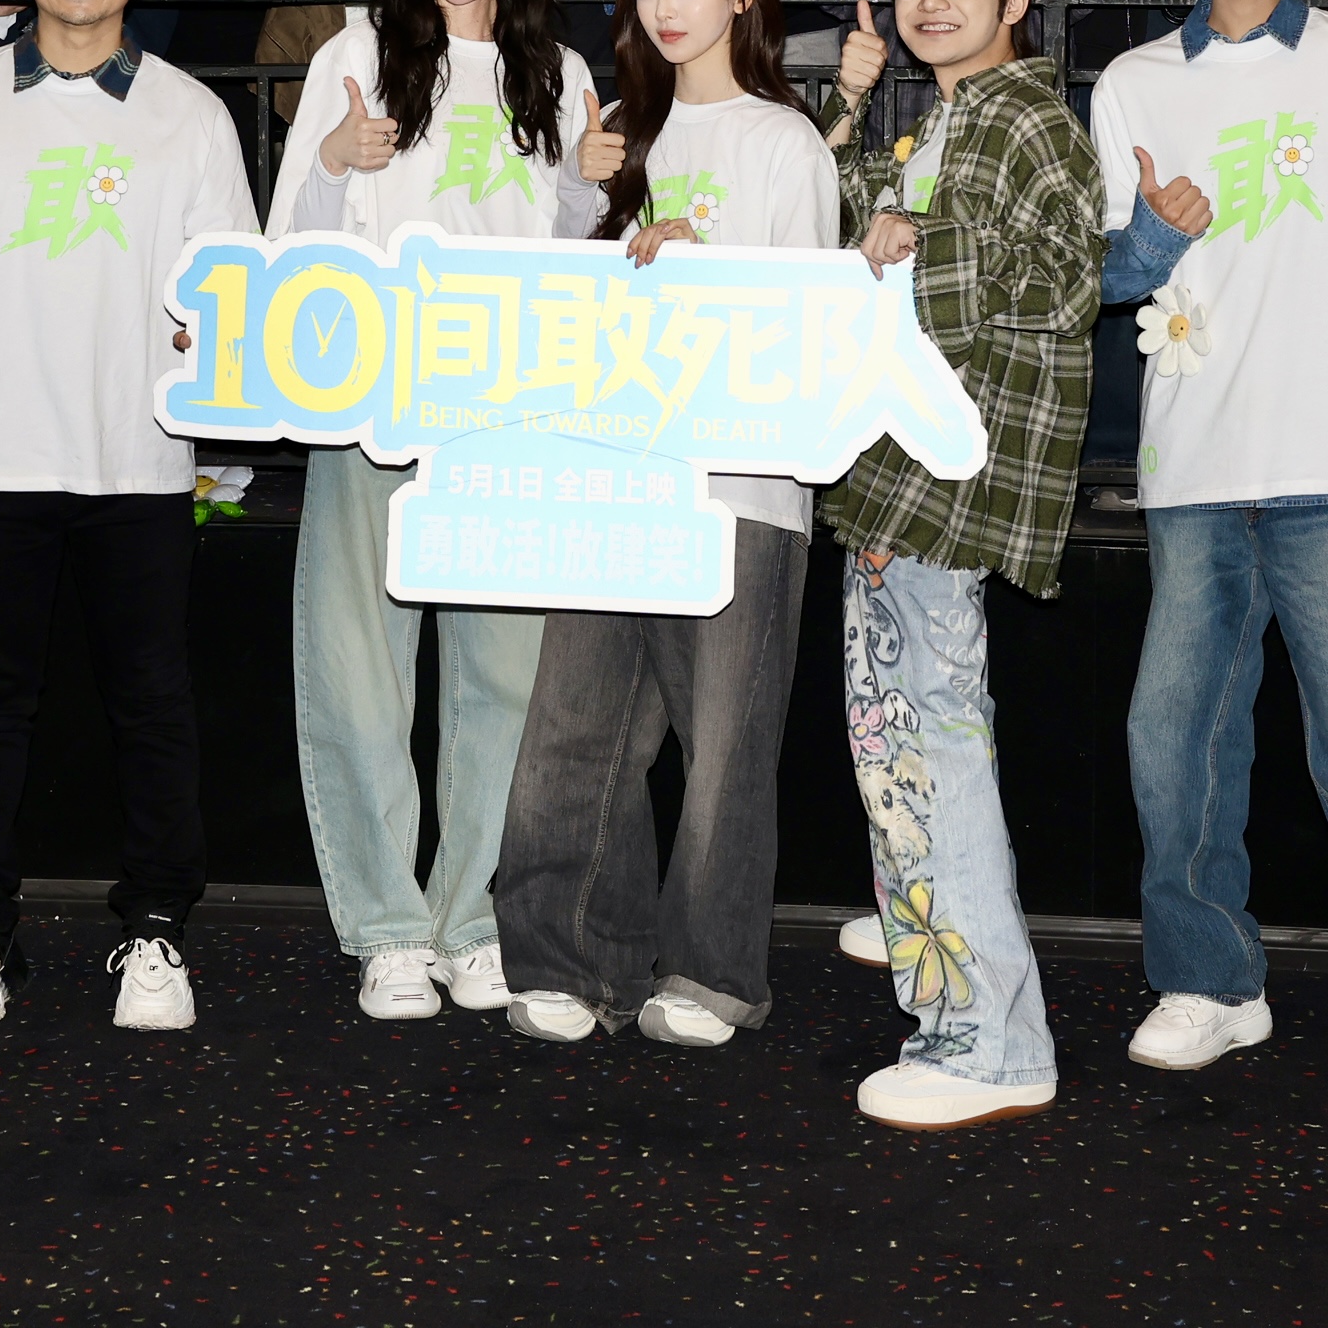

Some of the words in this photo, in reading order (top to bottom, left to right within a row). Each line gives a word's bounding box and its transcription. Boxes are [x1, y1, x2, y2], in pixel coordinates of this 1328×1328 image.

[0, 142, 136, 260] 敢
[430, 104, 535, 206] 敢
[1201, 111, 1325, 249] 敢
[183, 255, 949, 460] 10间敢死队
[519, 409, 650, 439] TOWARDS
[692, 415, 782, 445] DEATH
[447, 463, 544, 501] 5月1日
[553, 465, 678, 507] 全国上映
